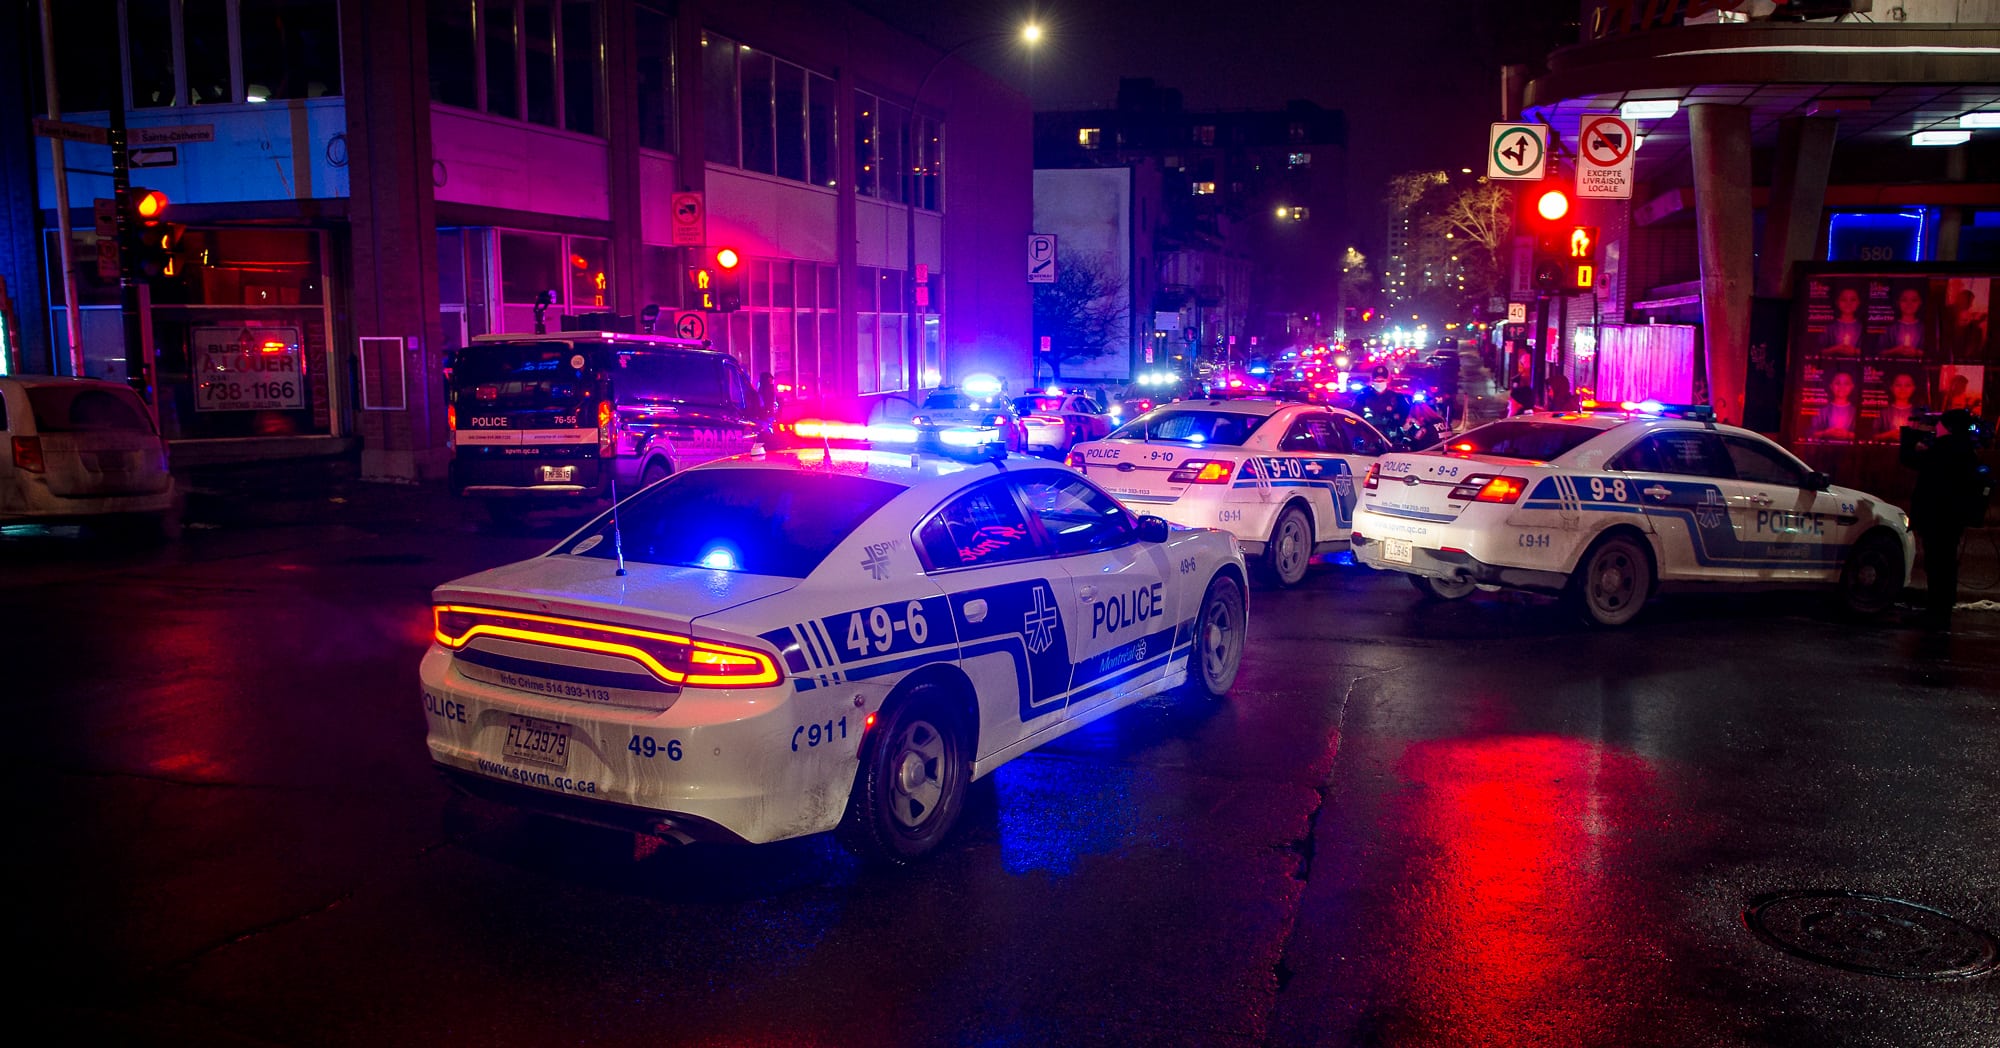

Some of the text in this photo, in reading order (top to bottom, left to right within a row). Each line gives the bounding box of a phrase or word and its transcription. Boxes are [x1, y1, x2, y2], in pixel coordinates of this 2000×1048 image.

[1583, 177, 1625, 185] LIVRAISON
[1035, 240, 1049, 258] P
[1861, 246, 1893, 262] 580
[1510, 308, 1523, 318] 40
[223, 354, 293, 373] LOUER
[471, 415, 577, 427] POLICE 76-55
[1086, 448, 1174, 461] POLICE 9-10
[1270, 458, 1301, 478] 9-10
[1382, 460, 1458, 477] POLICE 9-8
[1590, 477, 1628, 502] 9-8
[1841, 503, 1855, 513] 9-8
[1757, 510, 1825, 535] POLICE
[1526, 534, 1550, 547] 9-1-1
[1180, 556, 1196, 575] 49-6
[1092, 582, 1163, 639] POLICE
[845, 600, 929, 656] 49-6
[500, 674, 610, 701] Info Crime 514 393-1133
[506, 724, 567, 756] FLZ3979
[807, 716, 848, 747] 911
[628, 734, 683, 761] 49-6
[478, 758, 597, 794] www.spvm.qc.ca
